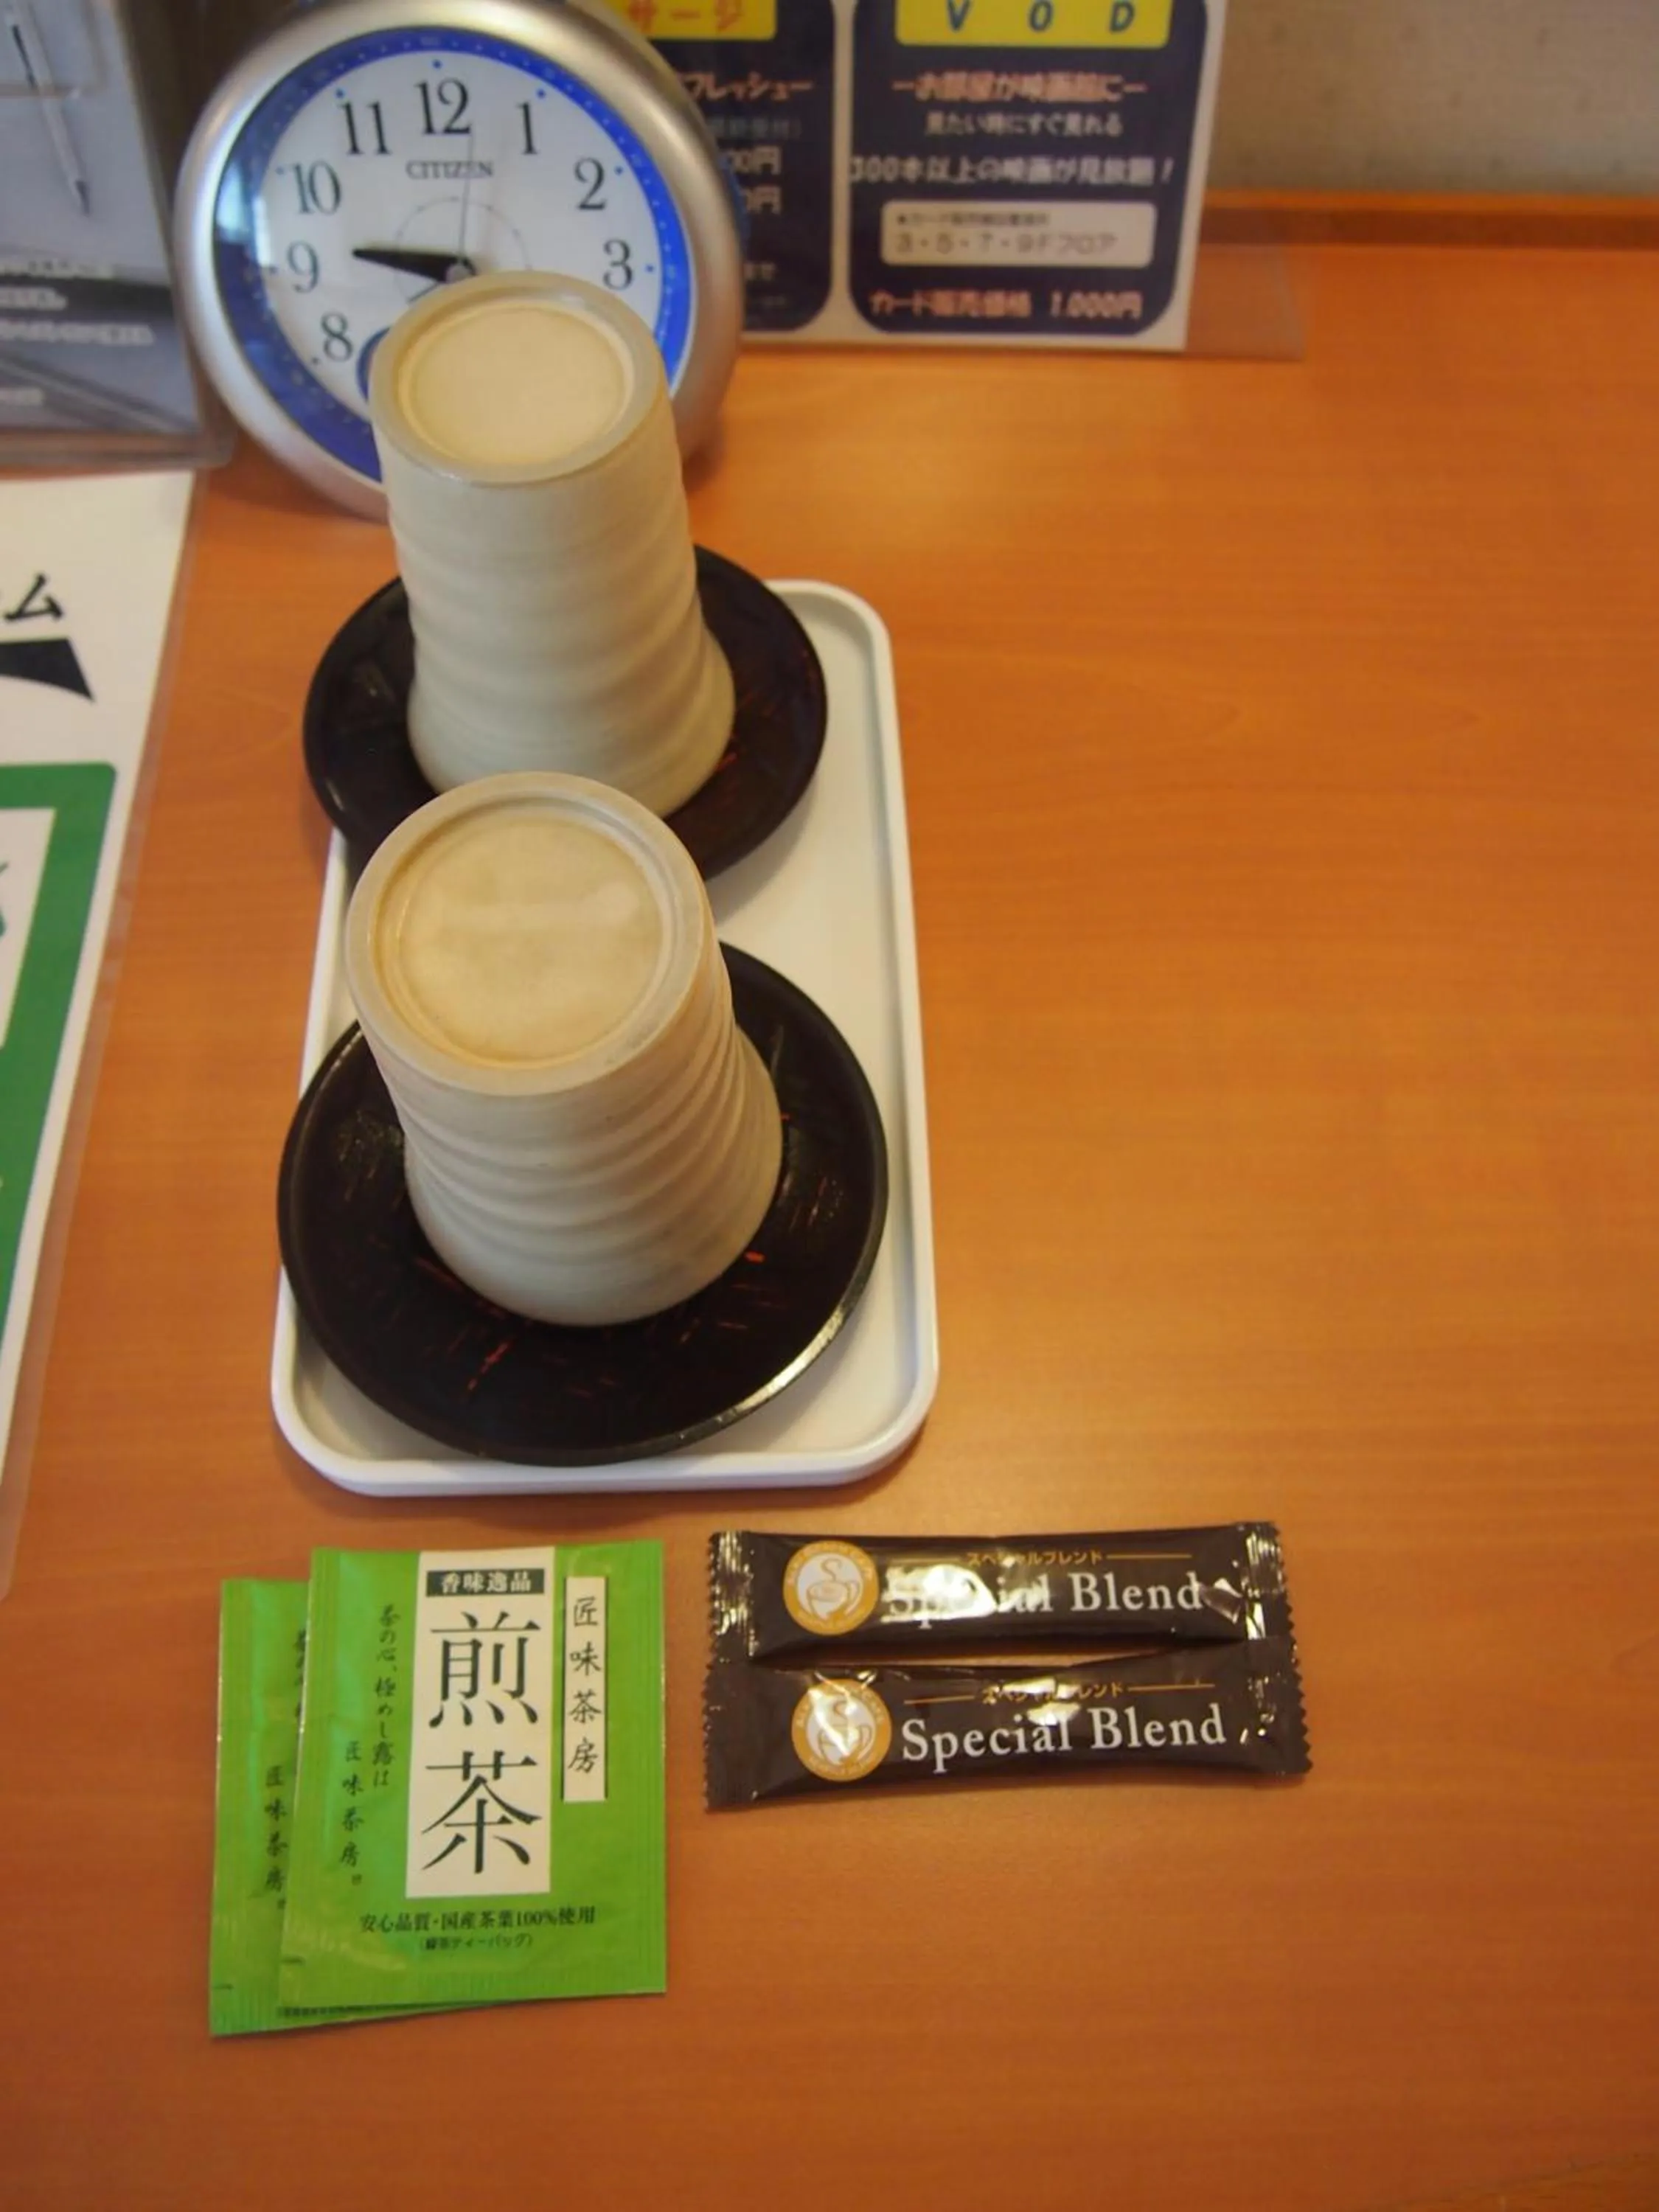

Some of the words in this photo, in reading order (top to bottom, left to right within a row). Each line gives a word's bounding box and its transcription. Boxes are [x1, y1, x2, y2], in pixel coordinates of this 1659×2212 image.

[341, 100, 392, 156] 11
[414, 77, 472, 136] 12
[518, 101, 538, 155] 1
[292, 160, 342, 215] 10
[406, 160, 494, 180] CITIZEN
[574, 157, 607, 211] 2
[288, 240, 320, 293] 9
[602, 238, 633, 291] 3
[320, 312, 354, 362] 8
[3, 573, 65, 622] ム
[441, 1570, 532, 1595] 香味逸品
[1068, 1571, 1204, 1612] Blend
[567, 1595, 603, 1775] 匠味茶房
[420, 1610, 543, 1875] 煎茶
[901, 1708, 1073, 1775] Special
[1088, 1703, 1227, 1750] Blend
